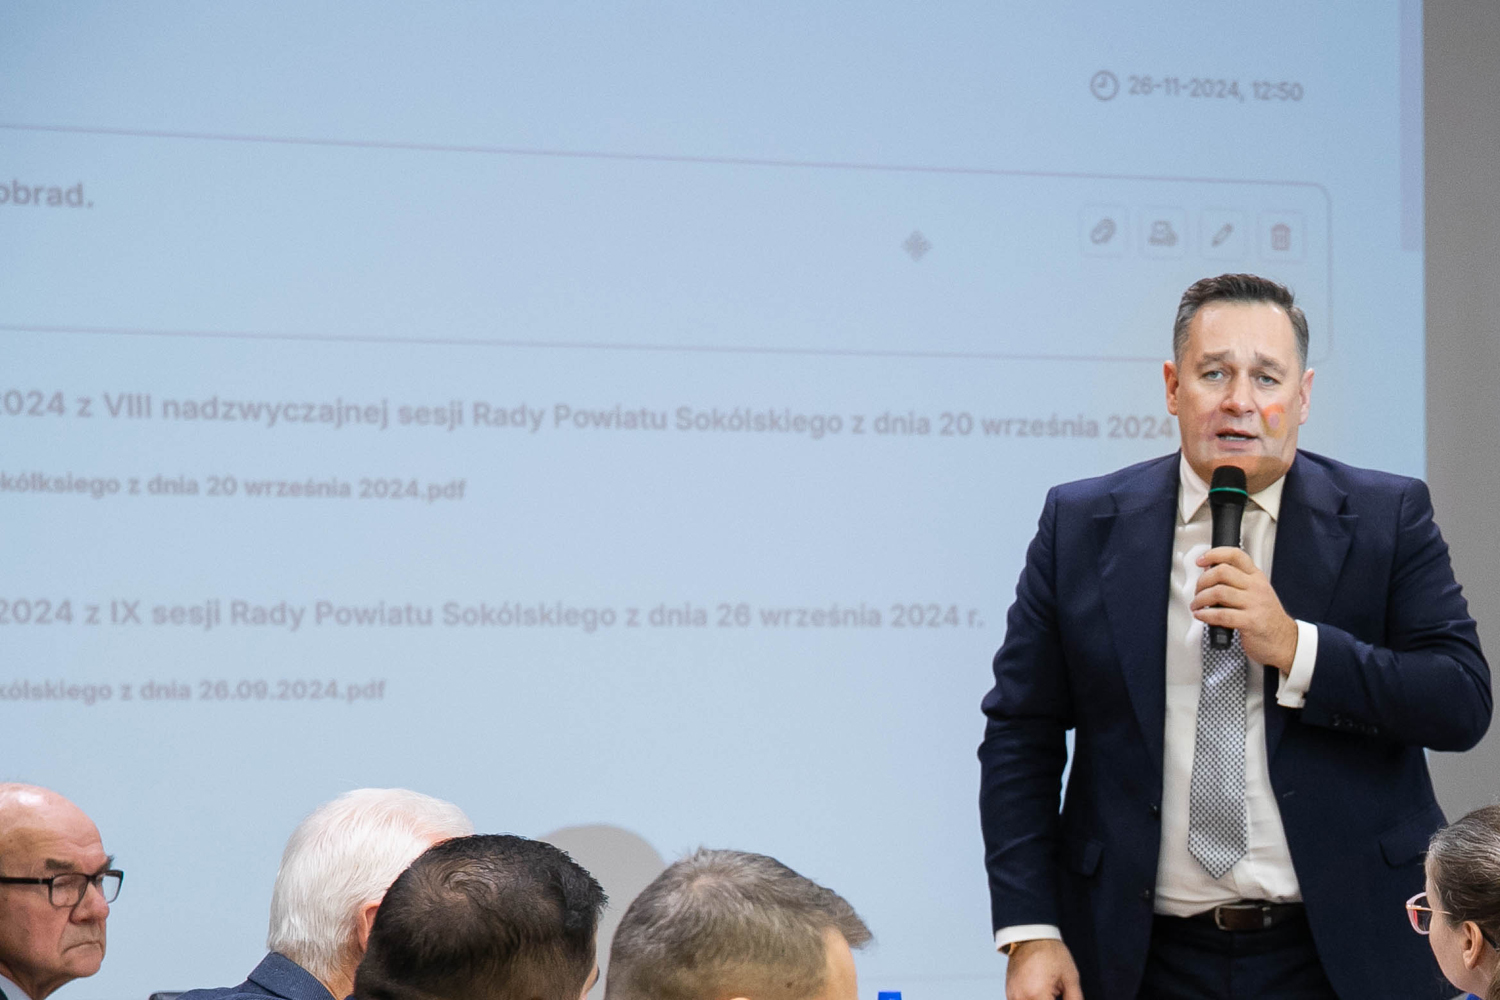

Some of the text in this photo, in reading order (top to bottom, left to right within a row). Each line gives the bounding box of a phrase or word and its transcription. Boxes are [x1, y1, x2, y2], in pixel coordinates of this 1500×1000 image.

[1253, 80, 1304, 101] 12:50
[0, 390, 1175, 440] 024 z VIII nadzwyczajnej sesji Rady Powiatu Sokólskiego z dnia 20 września 2024
[128, 477, 140, 494] z
[147, 473, 198, 495] dnia
[206, 476, 238, 497] 20
[244, 476, 351, 499] września
[359, 477, 467, 503] 2024.pdf
[84, 606, 101, 625] z
[110, 600, 142, 625] IX
[152, 600, 222, 631] sesji
[230, 600, 306, 632] Rady
[315, 600, 433, 627] Powiatu
[442, 600, 617, 634] Sokólskiego
[625, 606, 642, 627] z
[649, 602, 707, 627] dnia
[716, 603, 752, 628] 26
[759, 602, 882, 628] września
[890, 603, 960, 628] 2024
[967, 607, 985, 628] r.
[120, 684, 133, 701] z
[140, 679, 192, 701] dnia
[200, 678, 388, 705] 26.09.2024.pdf
